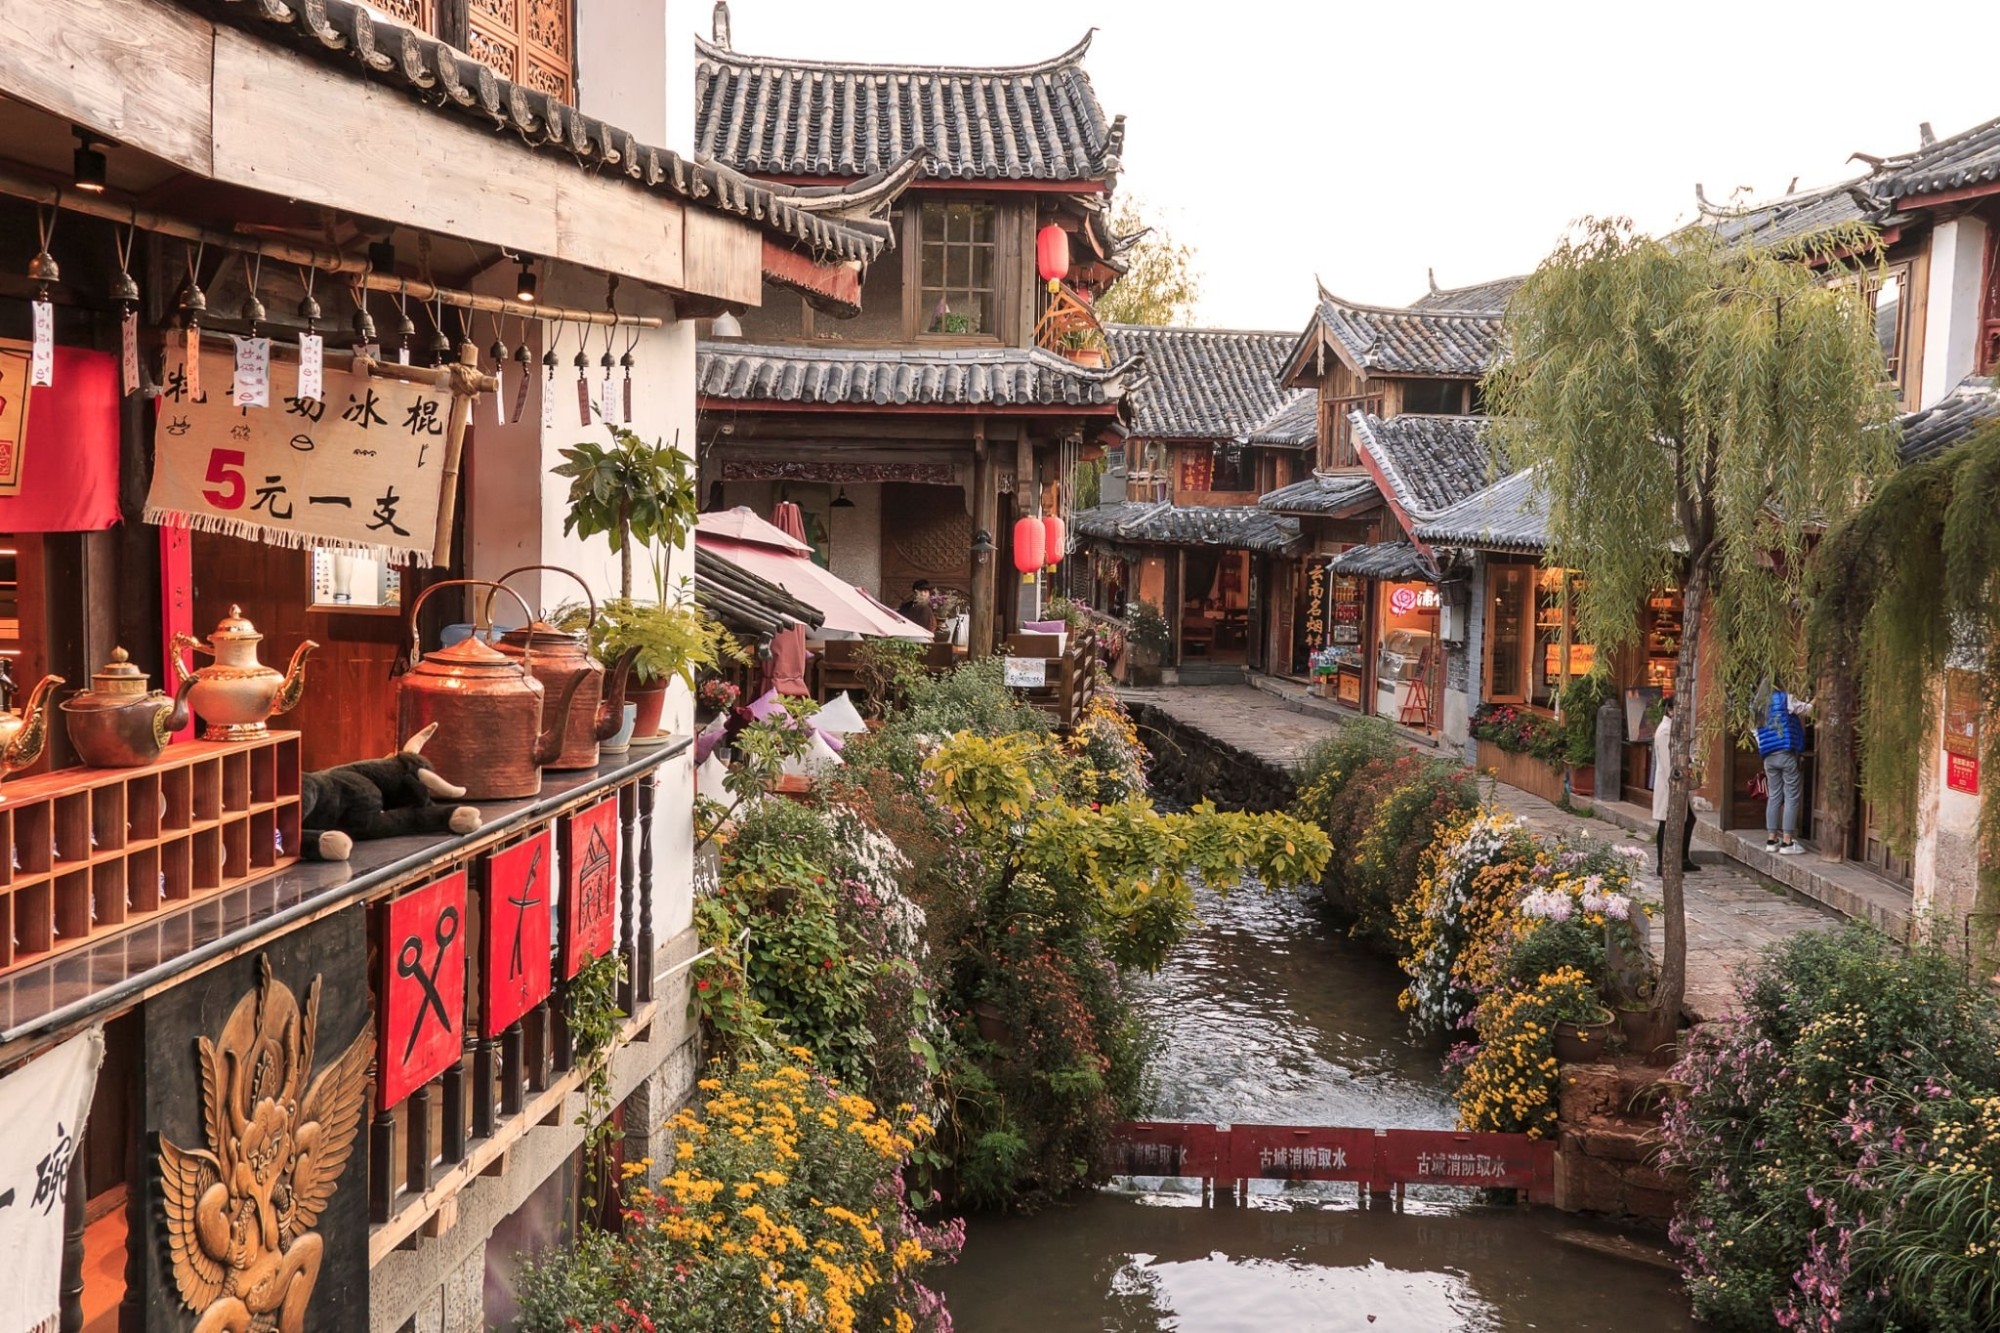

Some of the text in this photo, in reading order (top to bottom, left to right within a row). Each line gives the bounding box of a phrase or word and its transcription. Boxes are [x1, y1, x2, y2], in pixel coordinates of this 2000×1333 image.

[164, 363, 443, 436] 牦奶冰棍
[202, 448, 410, 536] 5元一支
[1259, 1146, 1347, 1170] 古城消防取水
[1416, 1151, 1506, 1178] 古城消防取水
